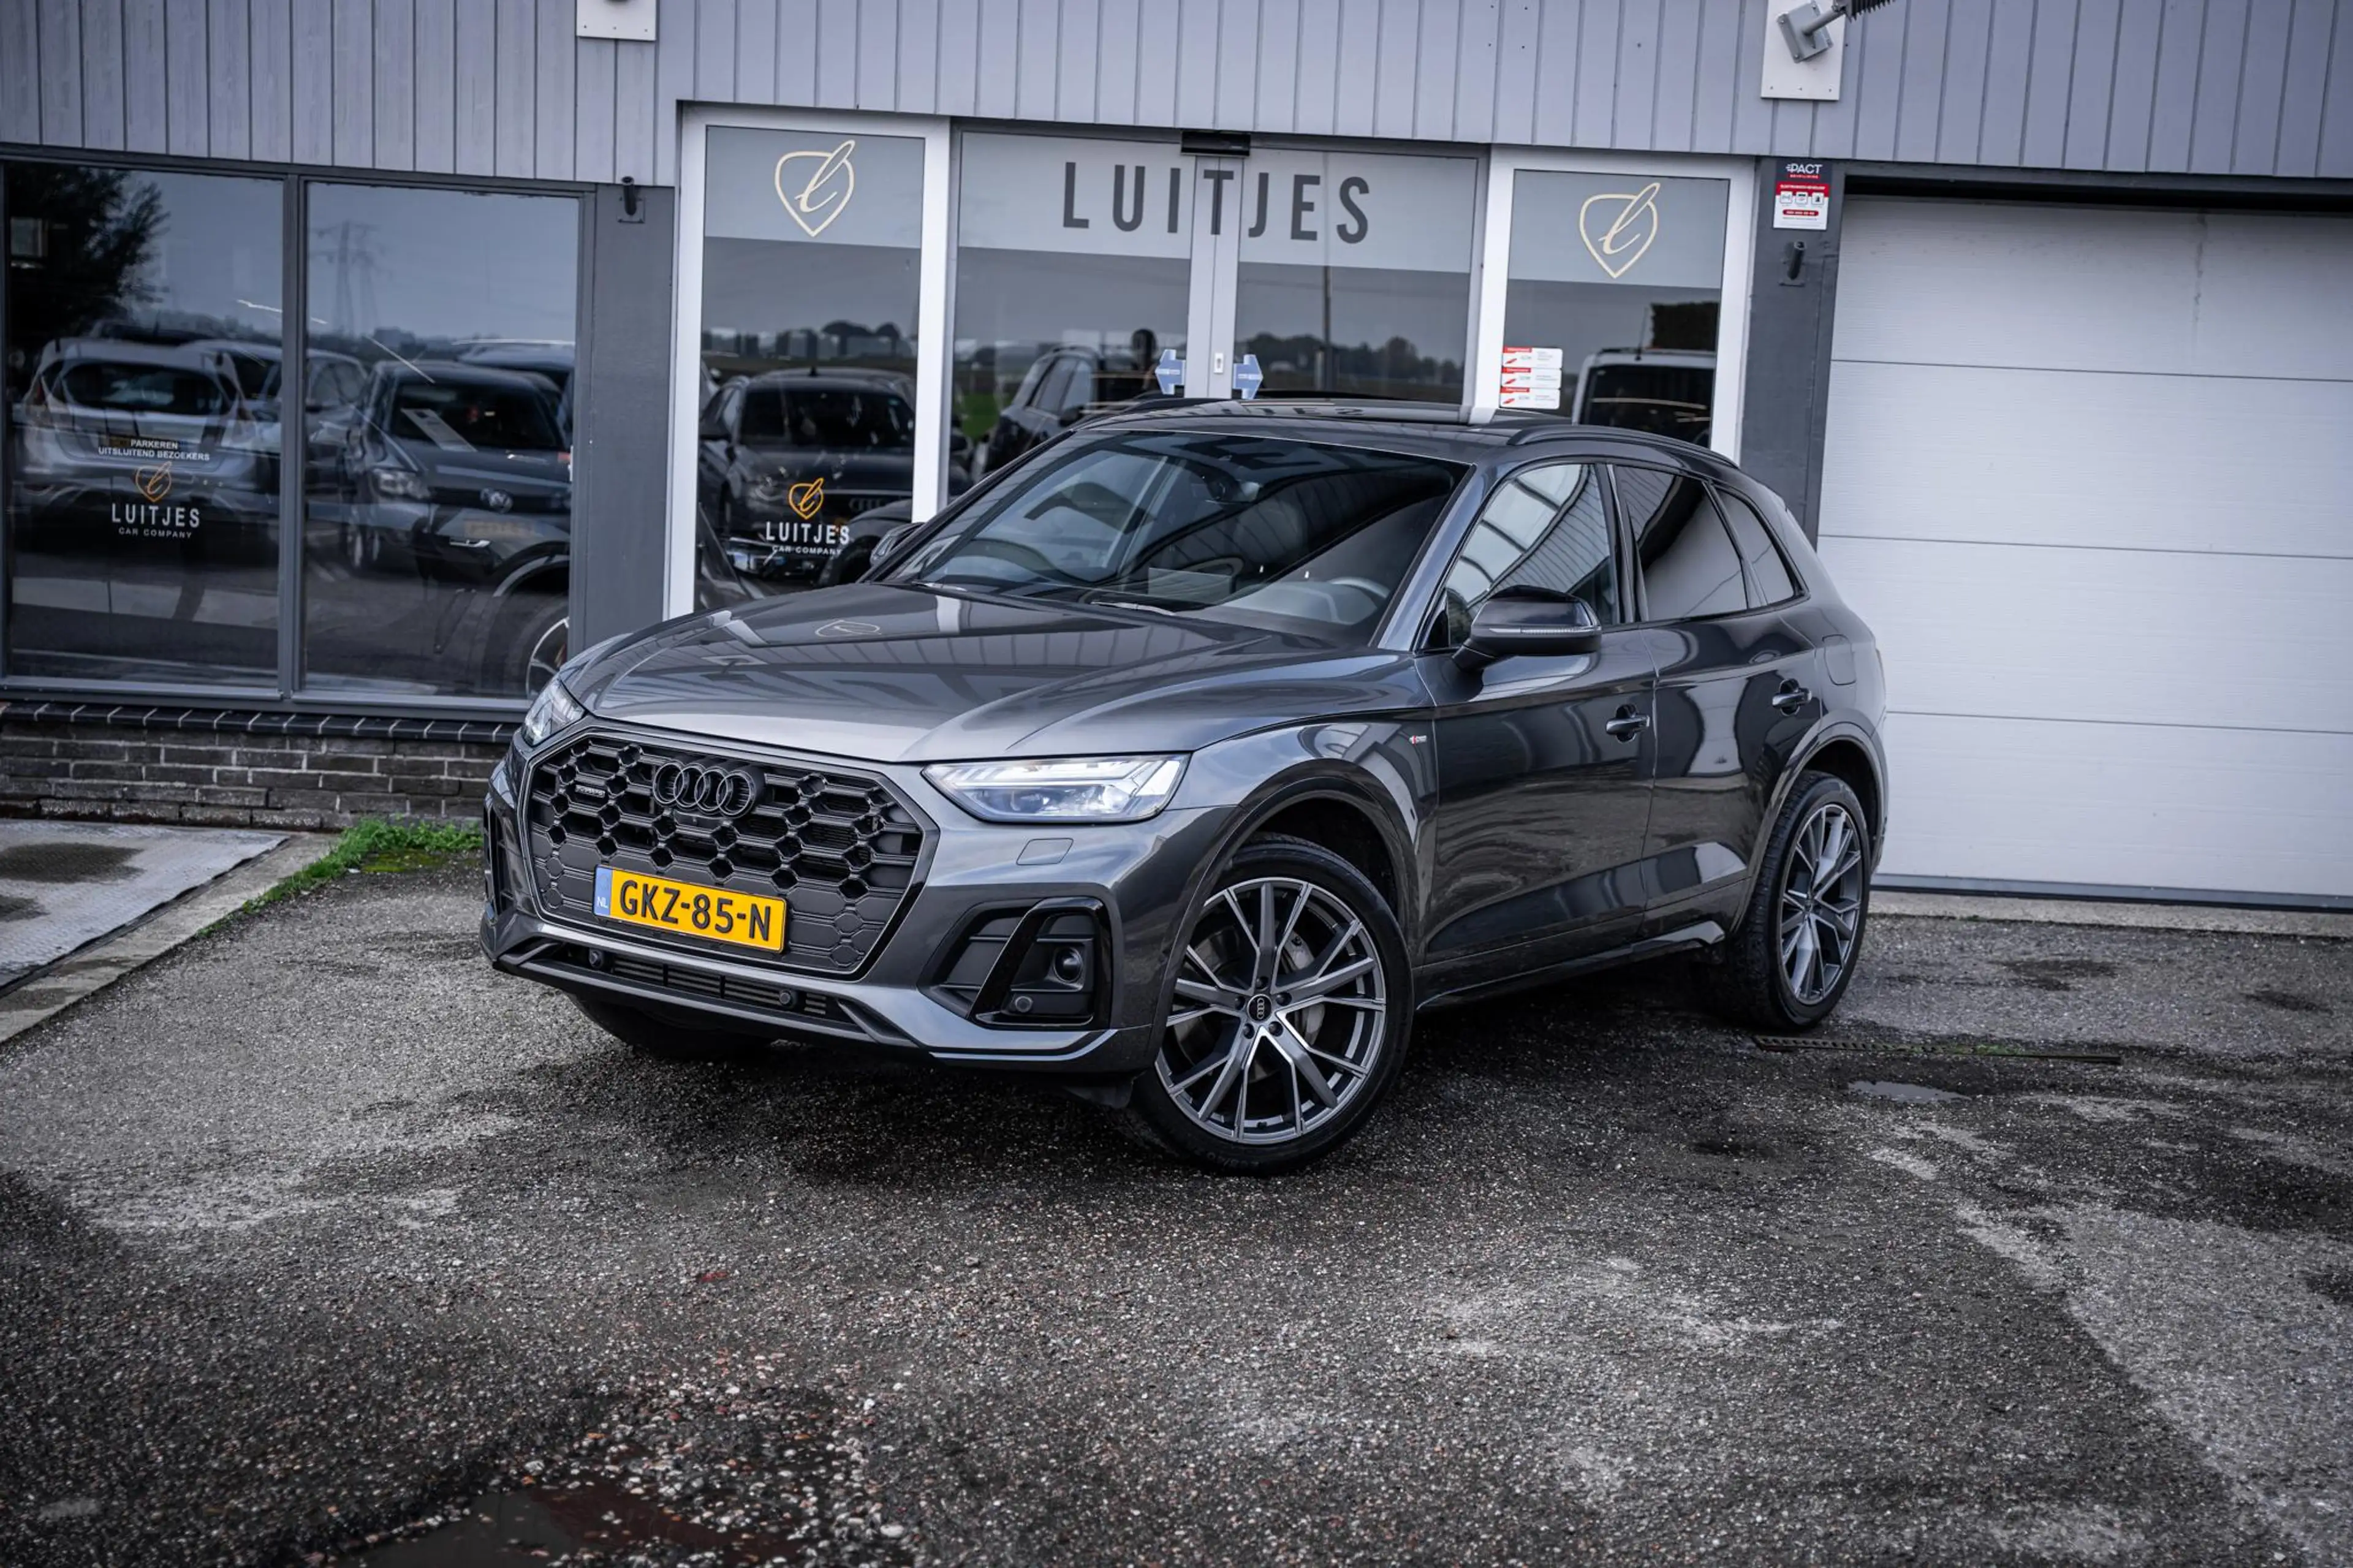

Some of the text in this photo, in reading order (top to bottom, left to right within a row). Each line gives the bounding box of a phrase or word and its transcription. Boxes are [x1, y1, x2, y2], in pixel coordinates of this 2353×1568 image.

[1787, 163, 1823, 174] PACT
[1063, 162, 1370, 244] LUITJES
[131, 439, 178, 450] PARKEREN
[98, 447, 210, 461] UITSLUITEND BEZOEKERS
[112, 503, 200, 528] LUITJES
[118, 527, 192, 539] CAR COMPANY
[766, 521, 849, 545] LUITJES
[795, 546, 842, 555] COMPANY
[597, 896, 608, 909] NL
[620, 880, 771, 942] GKZ-85-N
